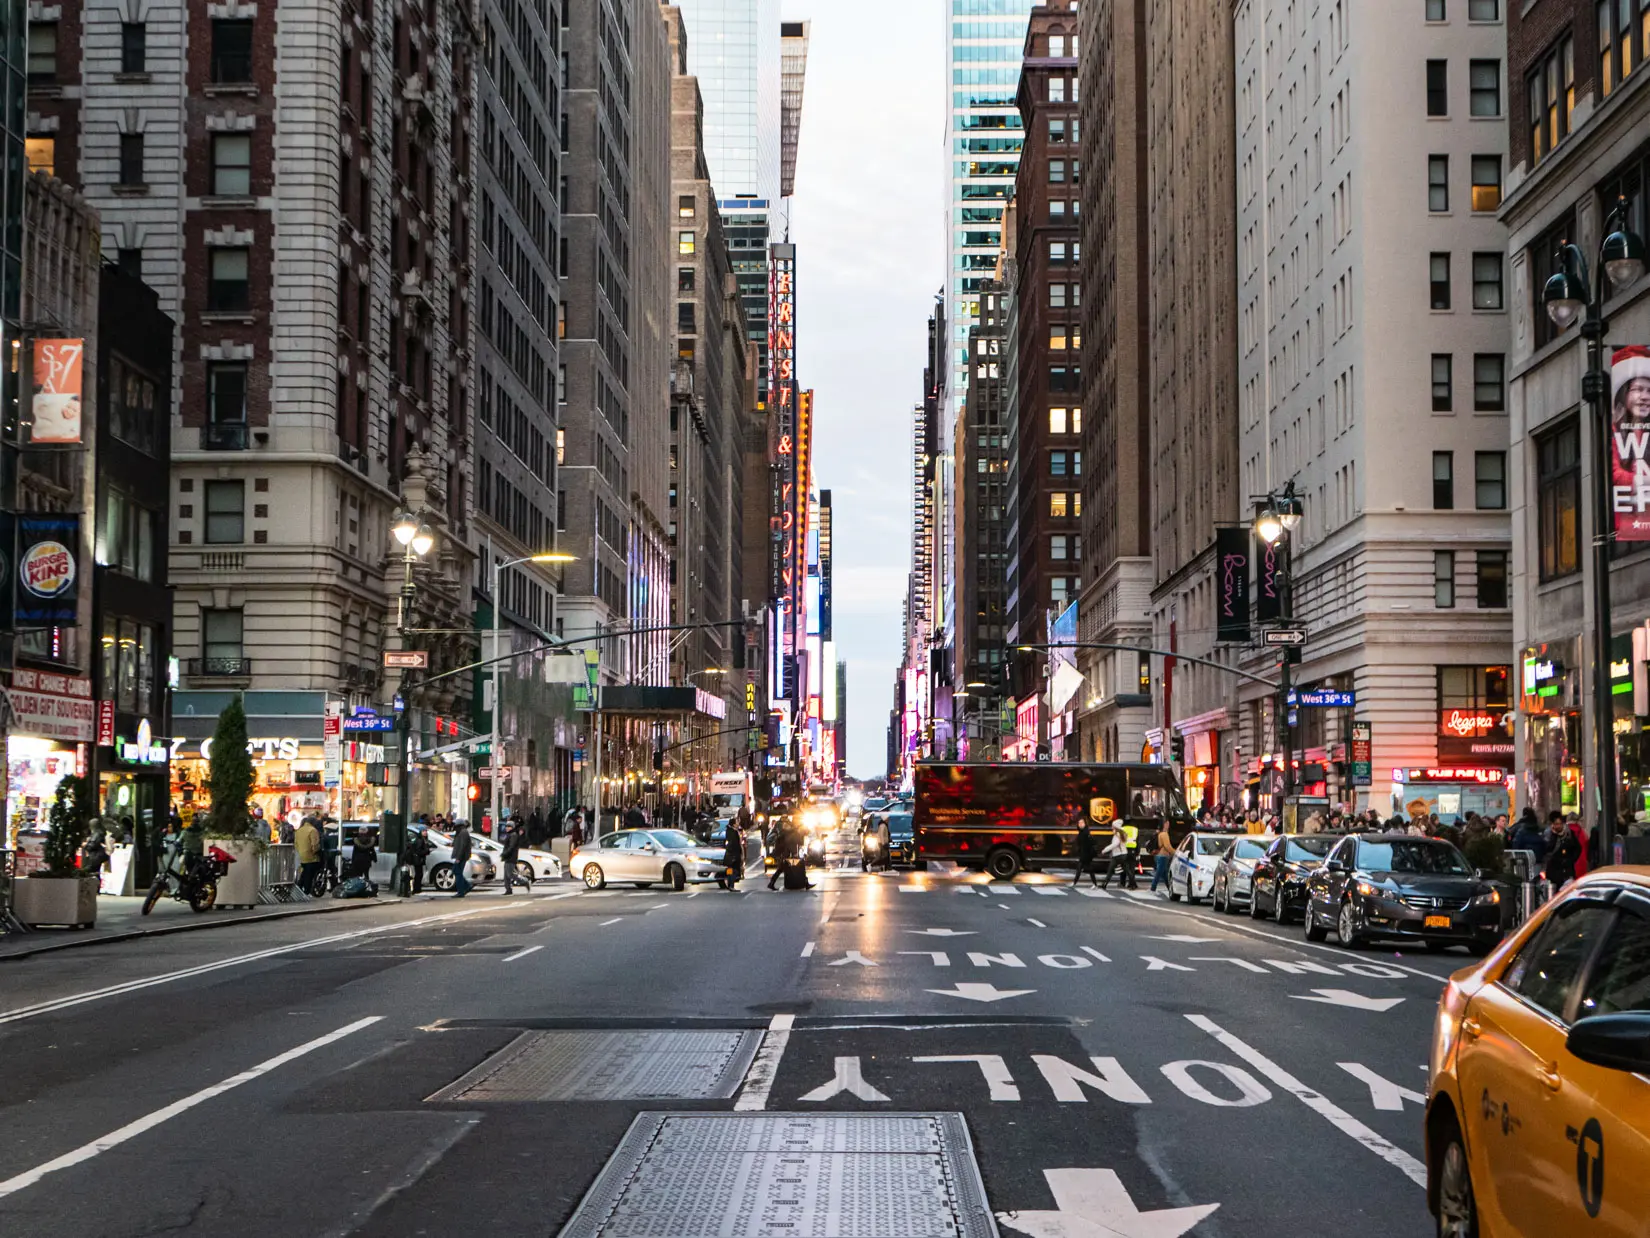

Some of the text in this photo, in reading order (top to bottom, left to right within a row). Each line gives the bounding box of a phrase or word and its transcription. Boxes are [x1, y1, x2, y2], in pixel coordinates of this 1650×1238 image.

[777, 274, 793, 406] ERNST
[41, 343, 83, 394] SPA 7
[27, 552, 68, 573] BURGER
[29, 562, 69, 585] KING
[1301, 694, 1323, 703] West
[1325, 694, 1340, 703] 36th
[1342, 694, 1351, 703] St
[343, 719, 390, 728] West 36th St
[1092, 804, 1113, 820] ups
[828, 950, 1096, 969] ONLY
[1139, 955, 1409, 979] ONLY
[797, 1055, 1273, 1108] ONLY
